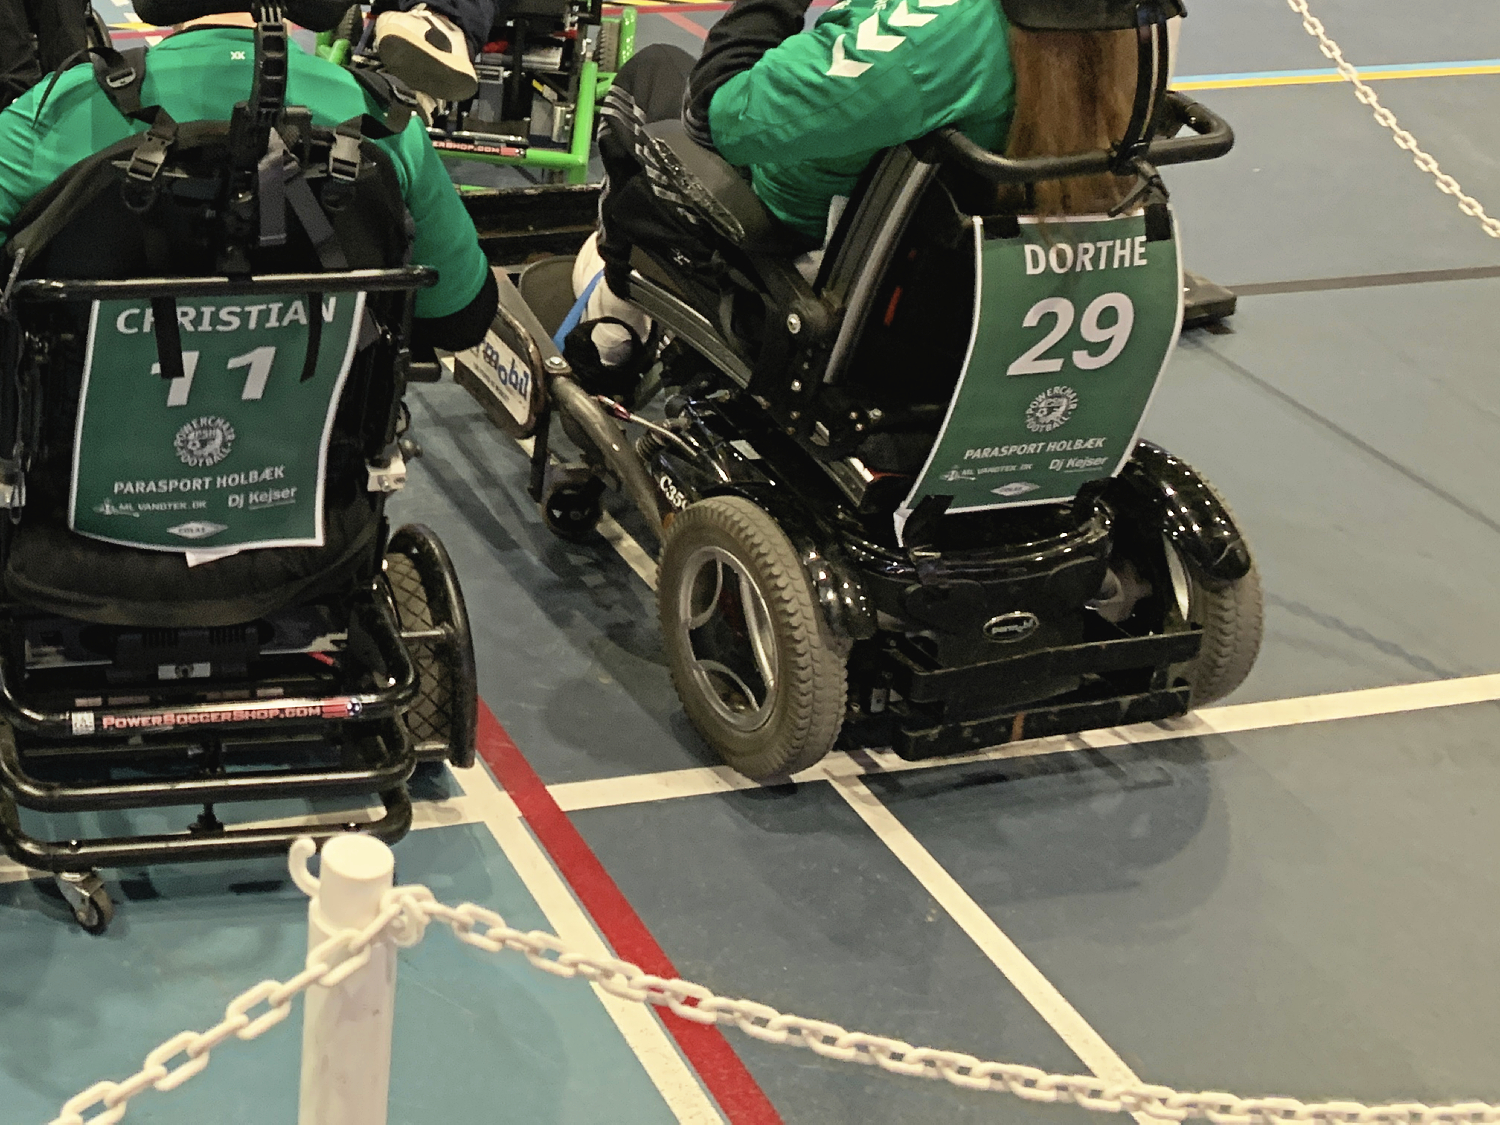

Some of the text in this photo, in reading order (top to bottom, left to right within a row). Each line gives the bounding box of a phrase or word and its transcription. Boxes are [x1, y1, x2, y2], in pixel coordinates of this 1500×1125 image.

[1024, 235, 1148, 276] DORTHE
[1006, 291, 1135, 376] 29
[151, 346, 276, 408] 11
[963, 437, 1107, 460] PARASPORT HOLBÆK
[1049, 456, 1109, 471] Dj Kejser
[113, 464, 286, 495] PARASPORT HOLBÆK
[249, 486, 298, 504] Kejser
